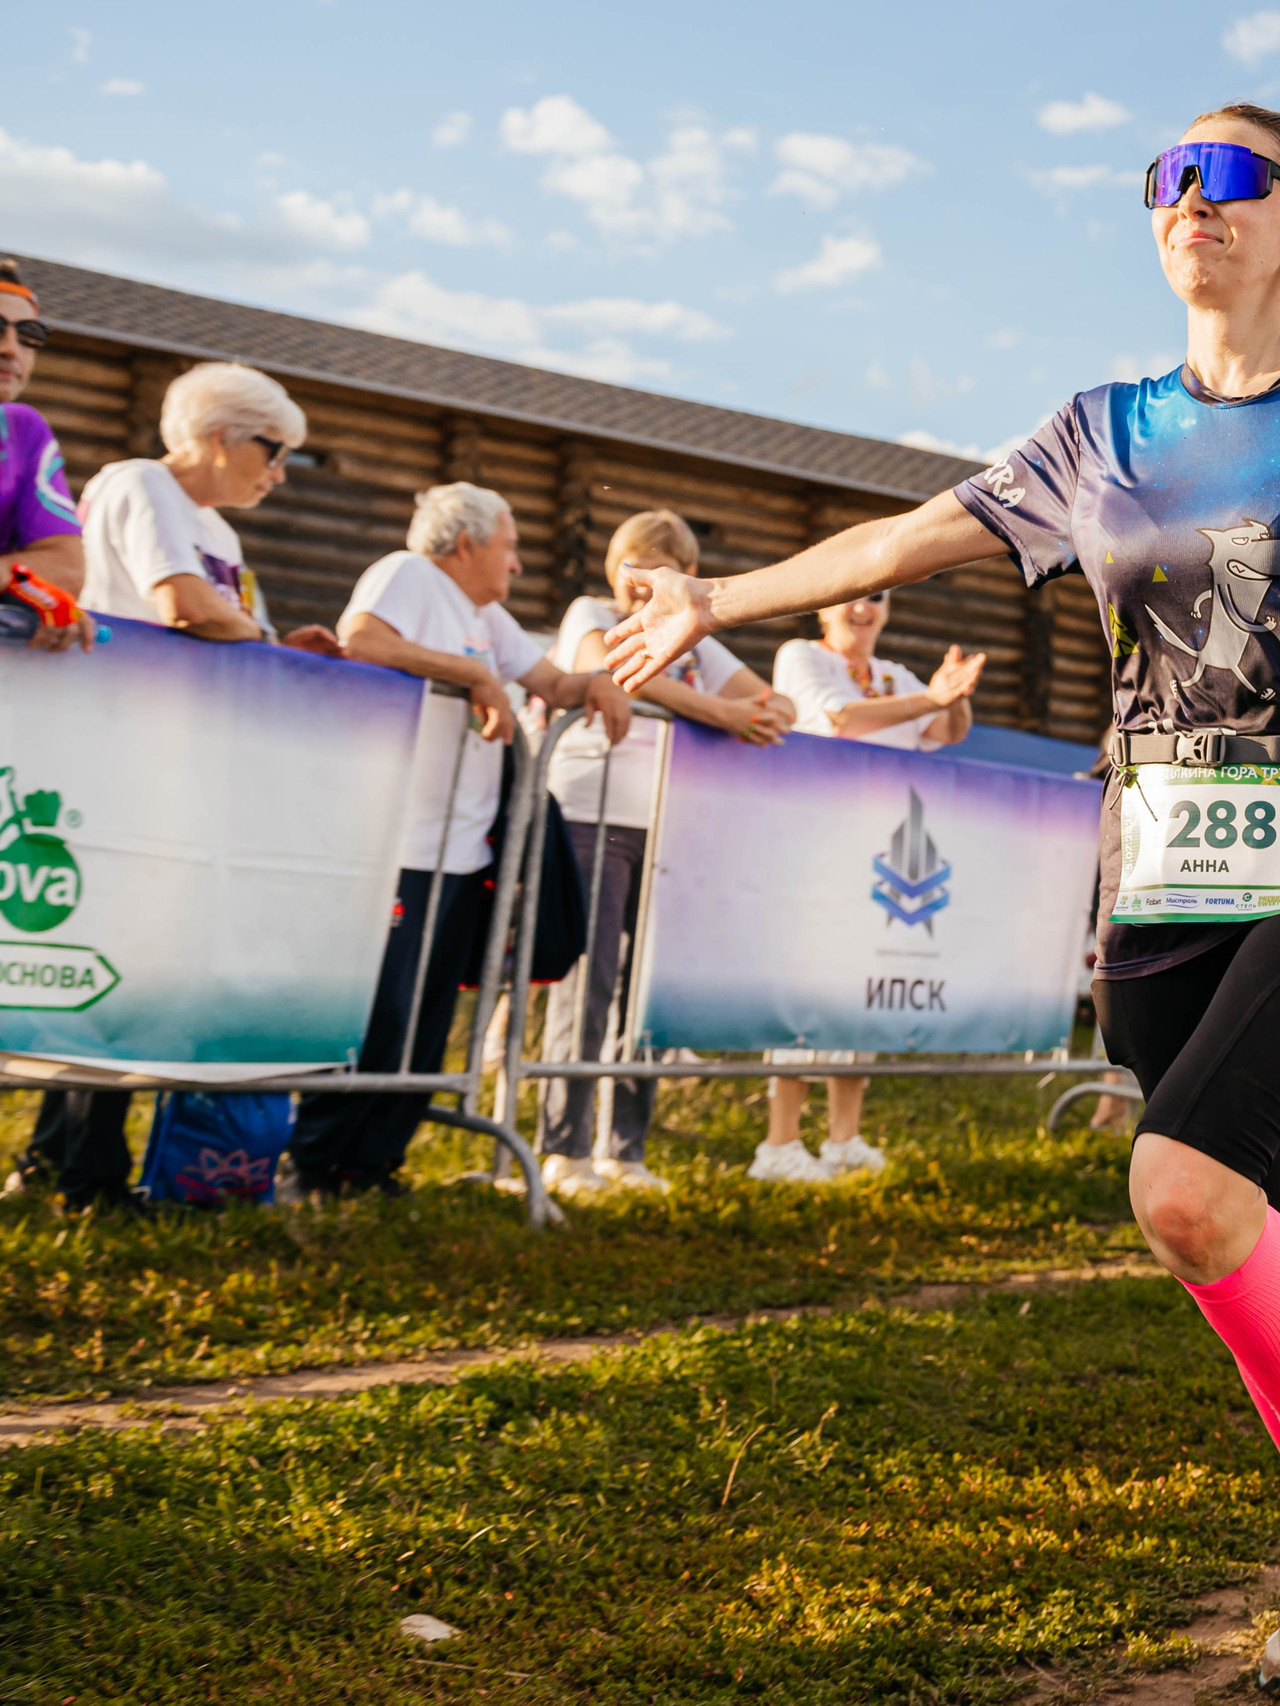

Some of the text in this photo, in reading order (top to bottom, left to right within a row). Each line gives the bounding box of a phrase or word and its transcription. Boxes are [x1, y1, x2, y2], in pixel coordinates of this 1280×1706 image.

[1220, 766, 1258, 781] ГОРА
[1166, 800, 1277, 850] 288
[1180, 859, 1230, 873] АННА
[0, 961, 96, 989] СНОВА
[866, 977, 946, 1011] ИПСК
